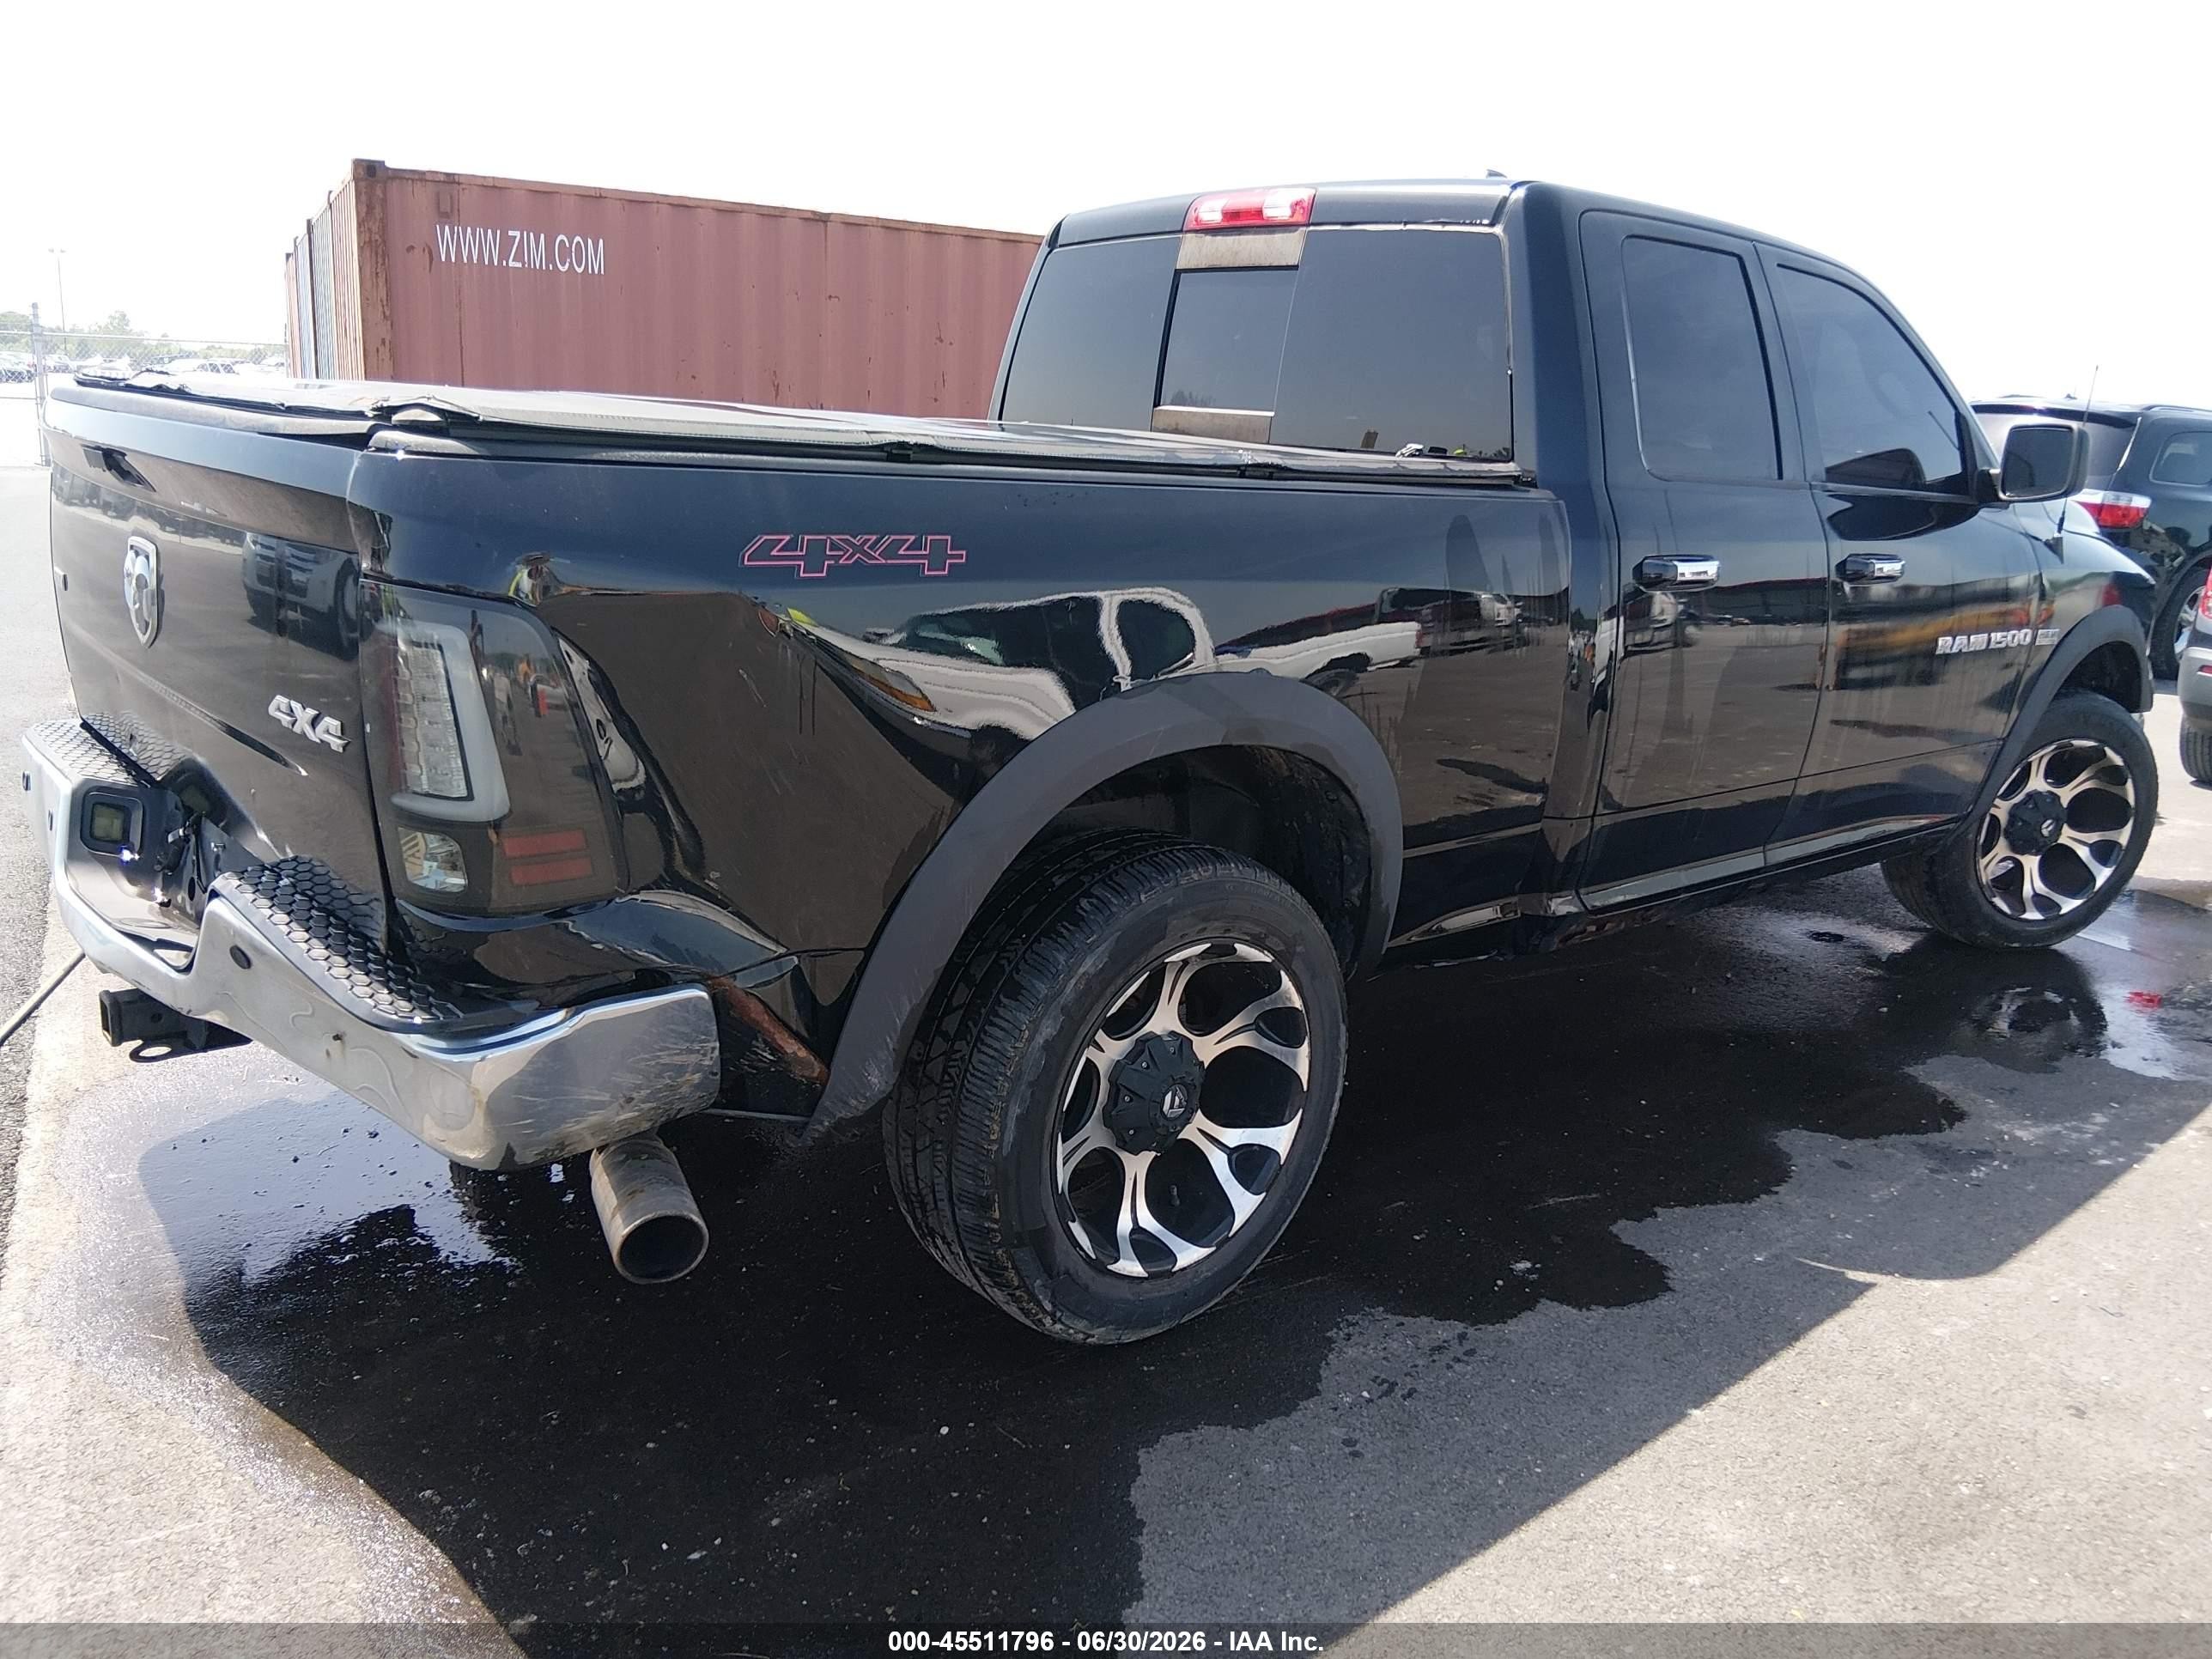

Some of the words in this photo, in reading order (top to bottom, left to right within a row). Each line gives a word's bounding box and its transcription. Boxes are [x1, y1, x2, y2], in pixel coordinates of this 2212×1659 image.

[436, 224, 605, 275] WWW.ZIM.COM
[1936, 634, 1989, 654] RAM
[1989, 629, 2033, 649] 1500
